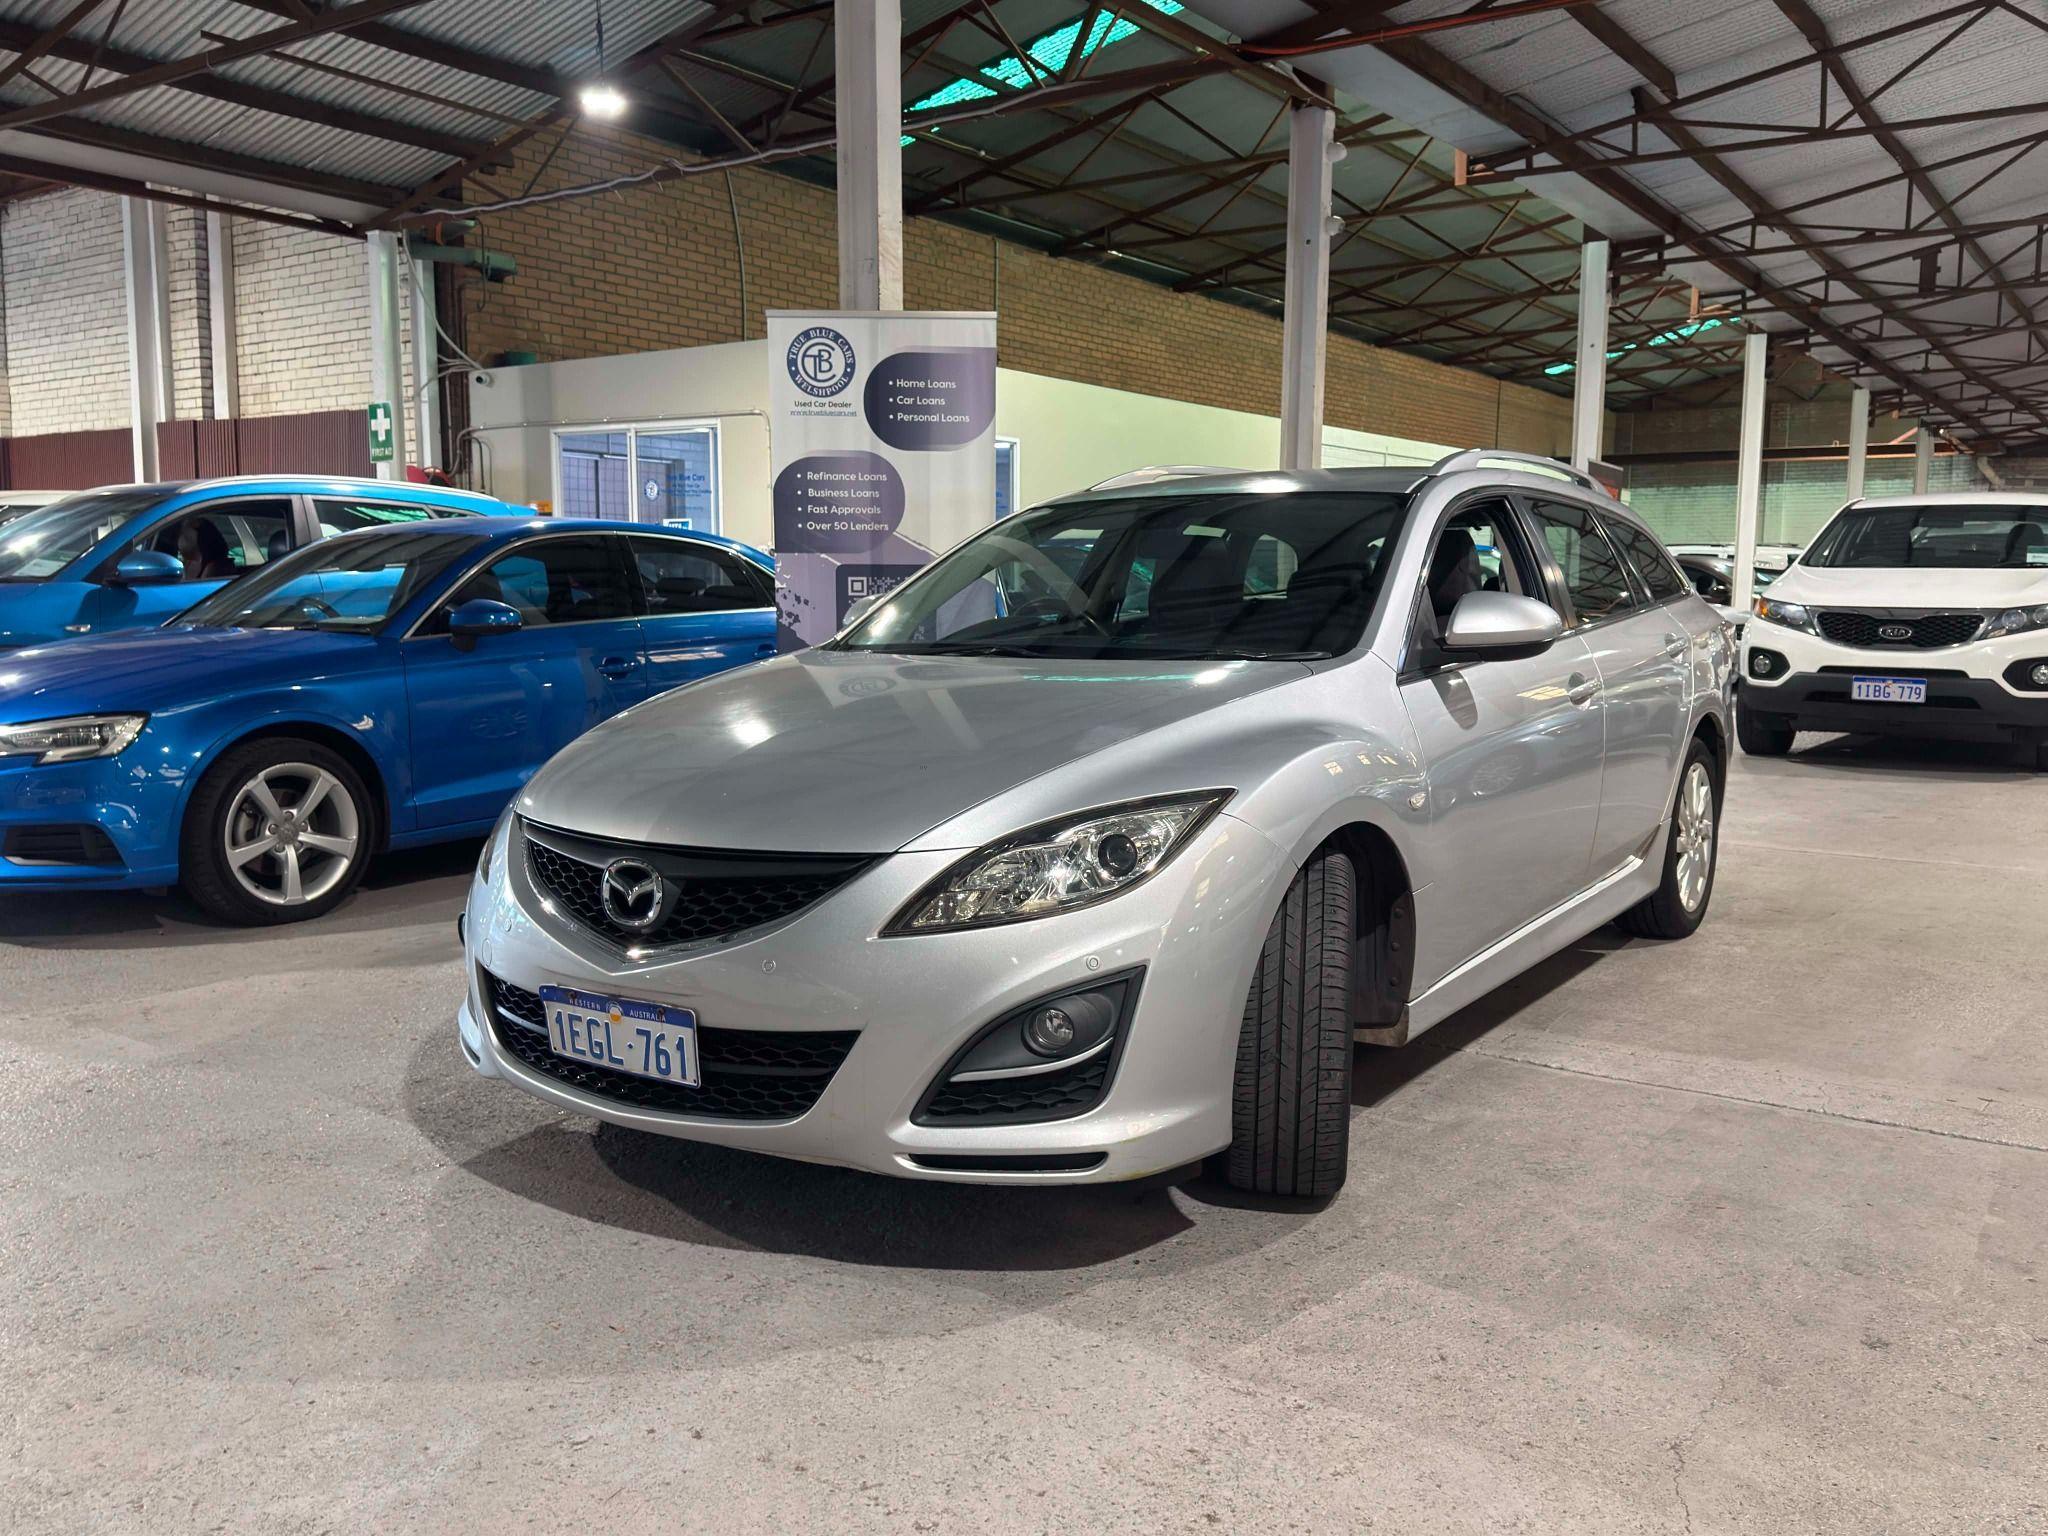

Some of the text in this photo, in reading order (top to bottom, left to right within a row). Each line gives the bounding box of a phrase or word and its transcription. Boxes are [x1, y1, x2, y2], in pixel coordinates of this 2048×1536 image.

[789, 328, 854, 364] TRUE BLUE CARS
[795, 374, 849, 396] WELSHPOOL
[896, 378, 957, 389] Home Loans
[794, 400, 852, 409] Used Car Dealer
[896, 395, 946, 405] Car Loans
[897, 412, 970, 423] Personal Loans
[807, 471, 888, 481] Refinance Loans
[808, 488, 880, 498] Business Loans
[807, 505, 881, 516] Fast Approvals
[806, 521, 889, 531] Over 50 Lenders
[569, 998, 667, 1023] WESTERN AUSTRALIA
